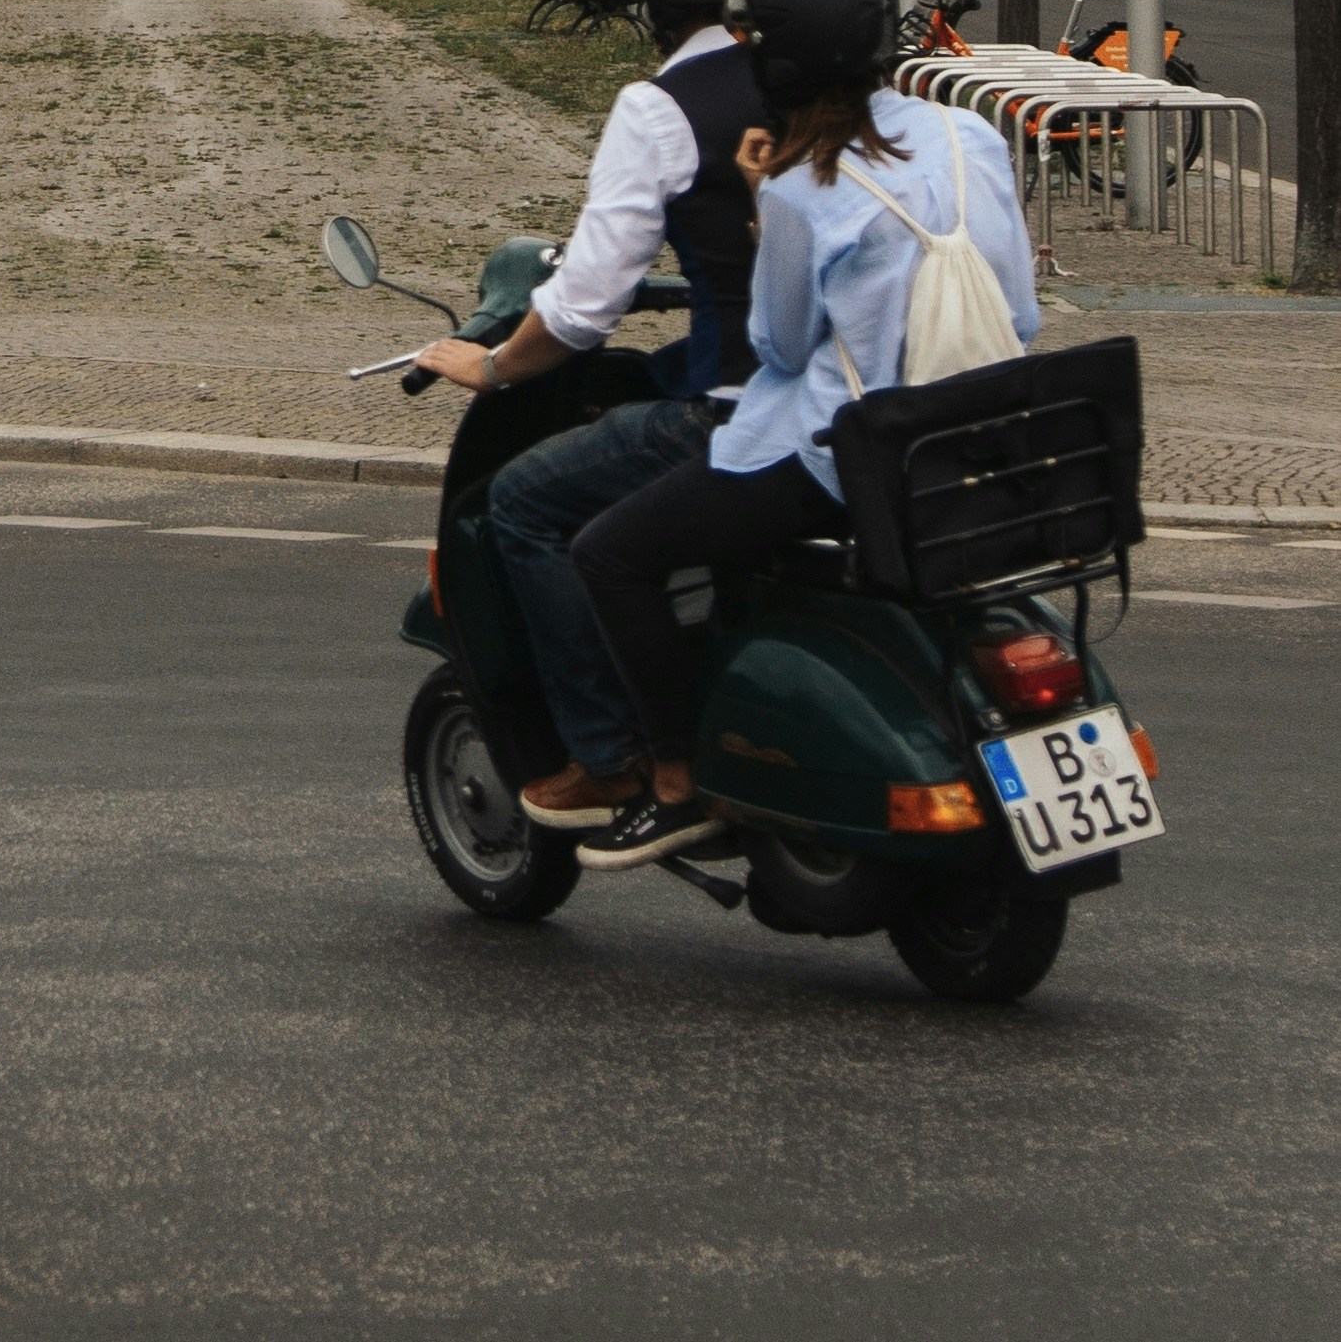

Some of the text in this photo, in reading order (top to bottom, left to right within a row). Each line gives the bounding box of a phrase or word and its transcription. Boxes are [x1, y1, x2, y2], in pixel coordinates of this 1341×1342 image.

[1042, 731, 1085, 785] B
[1004, 778, 1019, 794] D
[1058, 774, 1153, 844] 313
